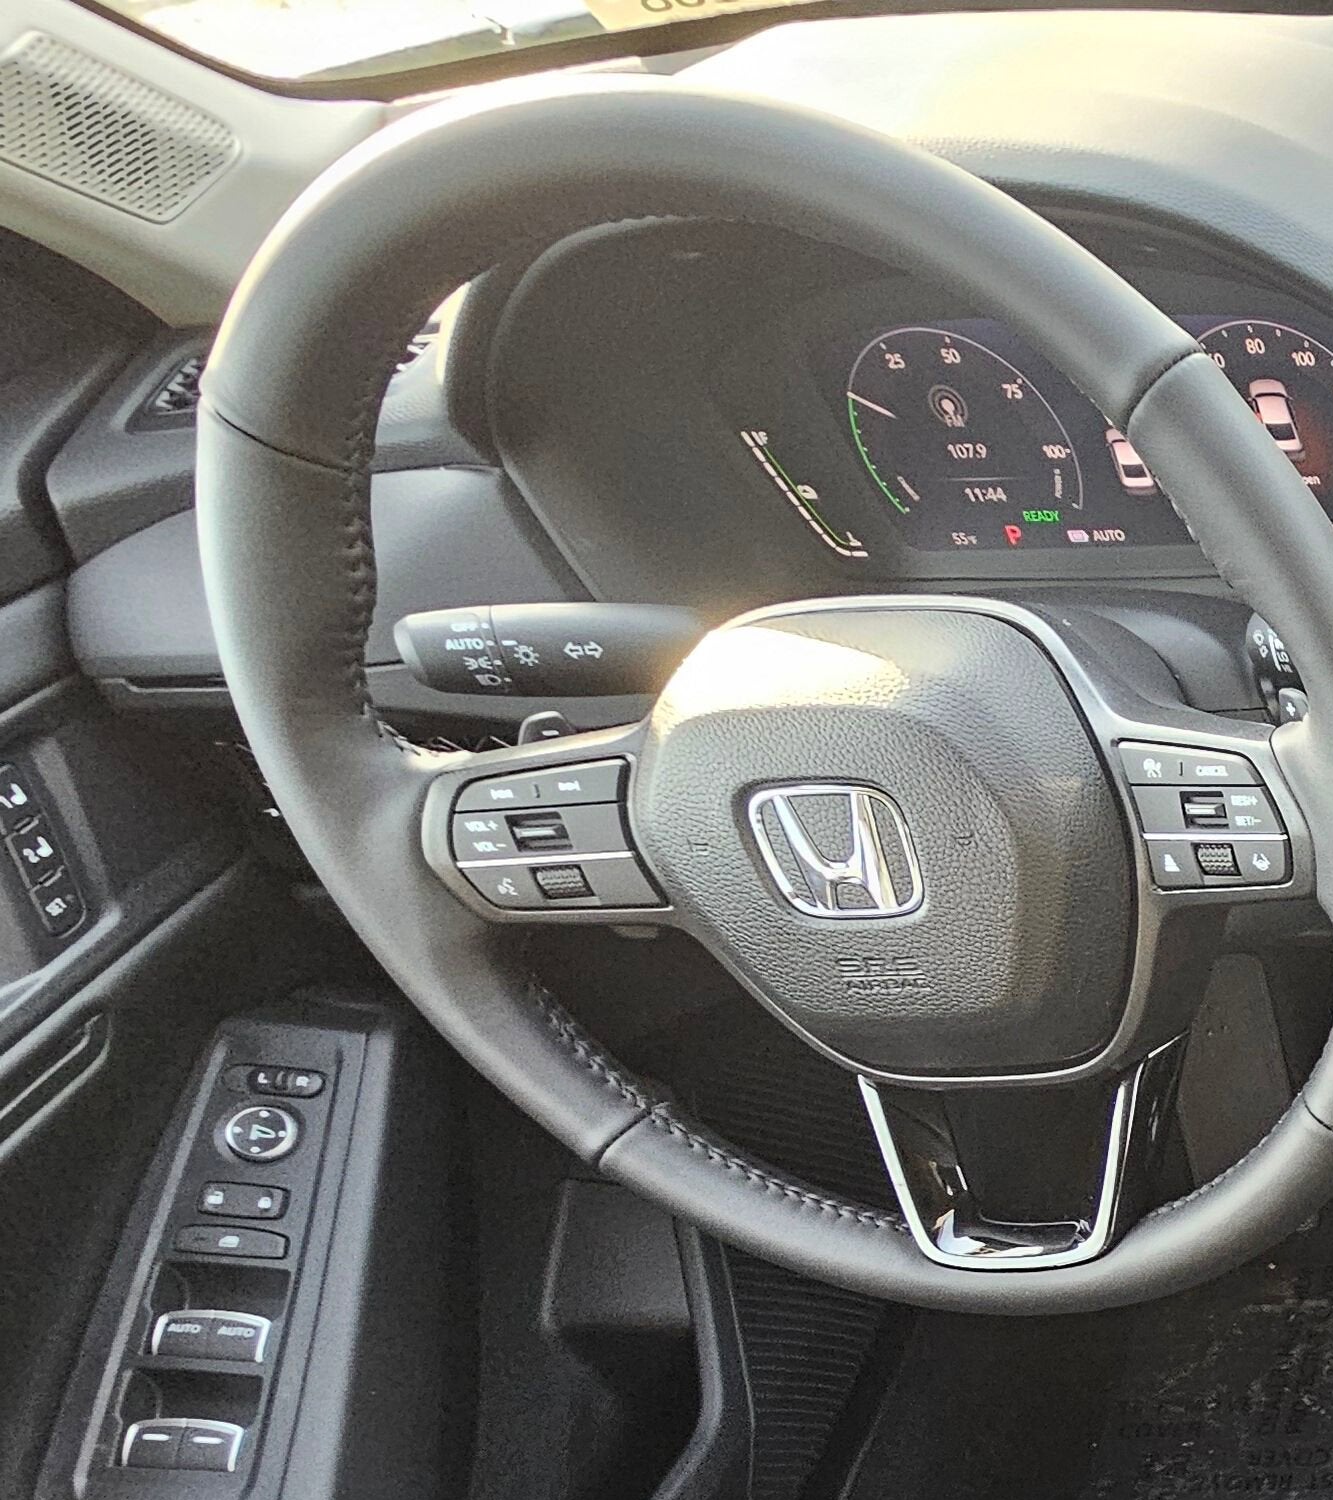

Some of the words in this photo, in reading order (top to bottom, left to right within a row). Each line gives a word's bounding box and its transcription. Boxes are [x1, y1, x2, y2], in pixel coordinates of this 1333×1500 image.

[1245, 338, 1266, 355] 80
[885, 352, 905, 370] 25
[940, 348, 961, 365] 50
[1291, 351, 1315, 368] 100
[1001, 383, 1023, 400] 75
[946, 442, 988, 460] 107.9
[1042, 444, 1067, 461] 100
[964, 485, 1008, 503] 11:44
[1023, 509, 1060, 524] READY
[1004, 524, 1022, 545] P
[1092, 528, 1126, 543] AUTO
[445, 637, 484, 650] AUTO
[167, 1322, 201, 1335] AUTO
[217, 1325, 255, 1339] AUTO
